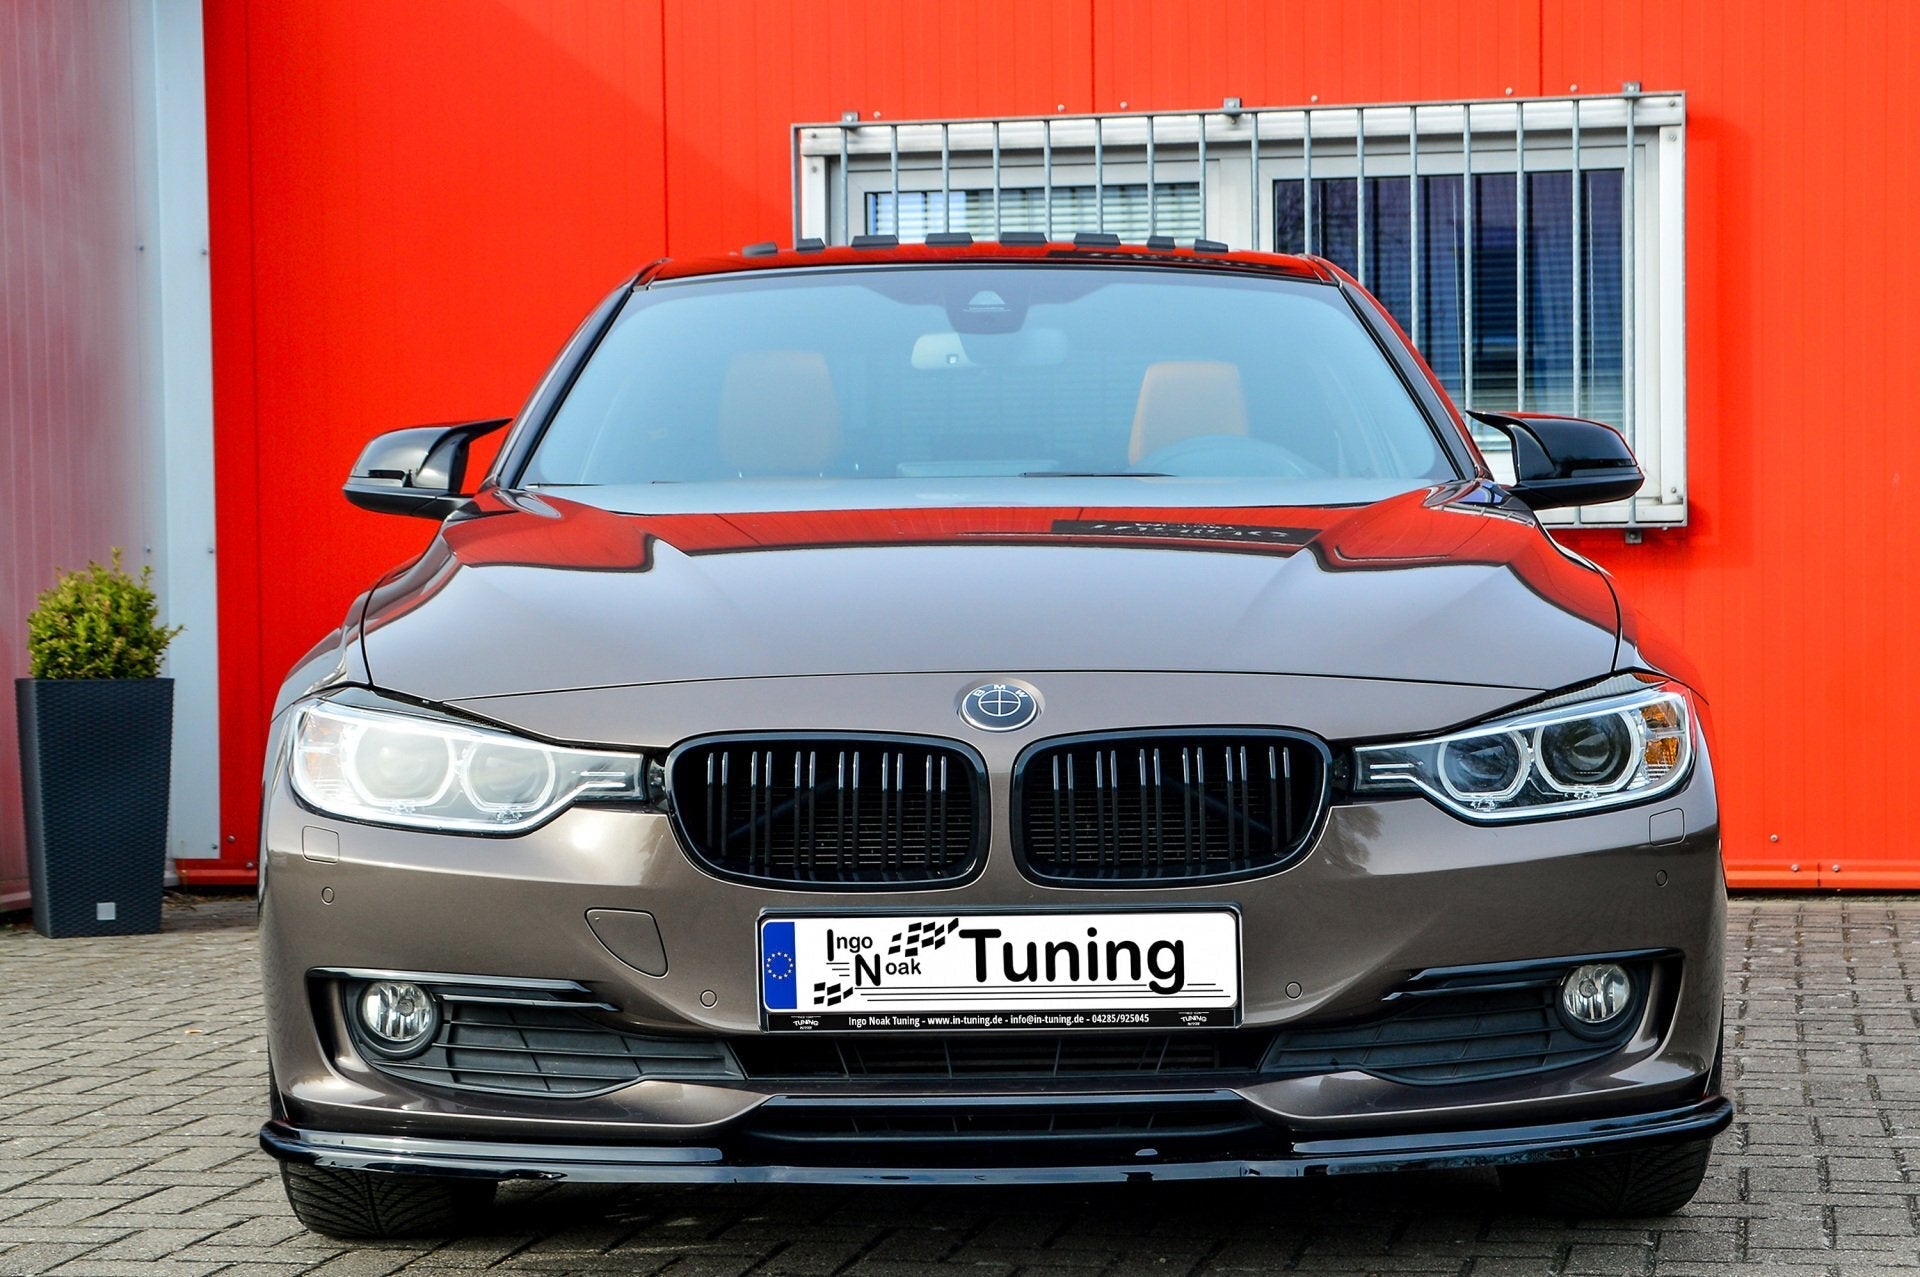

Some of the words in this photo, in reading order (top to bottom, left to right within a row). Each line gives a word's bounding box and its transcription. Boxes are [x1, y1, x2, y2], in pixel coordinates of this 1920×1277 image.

[973, 684, 1028, 698] BMW
[827, 928, 873, 962] Ingo
[958, 926, 1186, 995] Tuning
[855, 953, 922, 987] Noak
[848, 1016, 867, 1026] Ingo
[868, 1016, 891, 1025] Noak
[892, 1016, 920, 1027] Tuning
[927, 1015, 1003, 1027] www.in-tuning.de
[1010, 1014, 1084, 1026] info@in-tuning.de
[1091, 1013, 1150, 1024] 04285/925045
